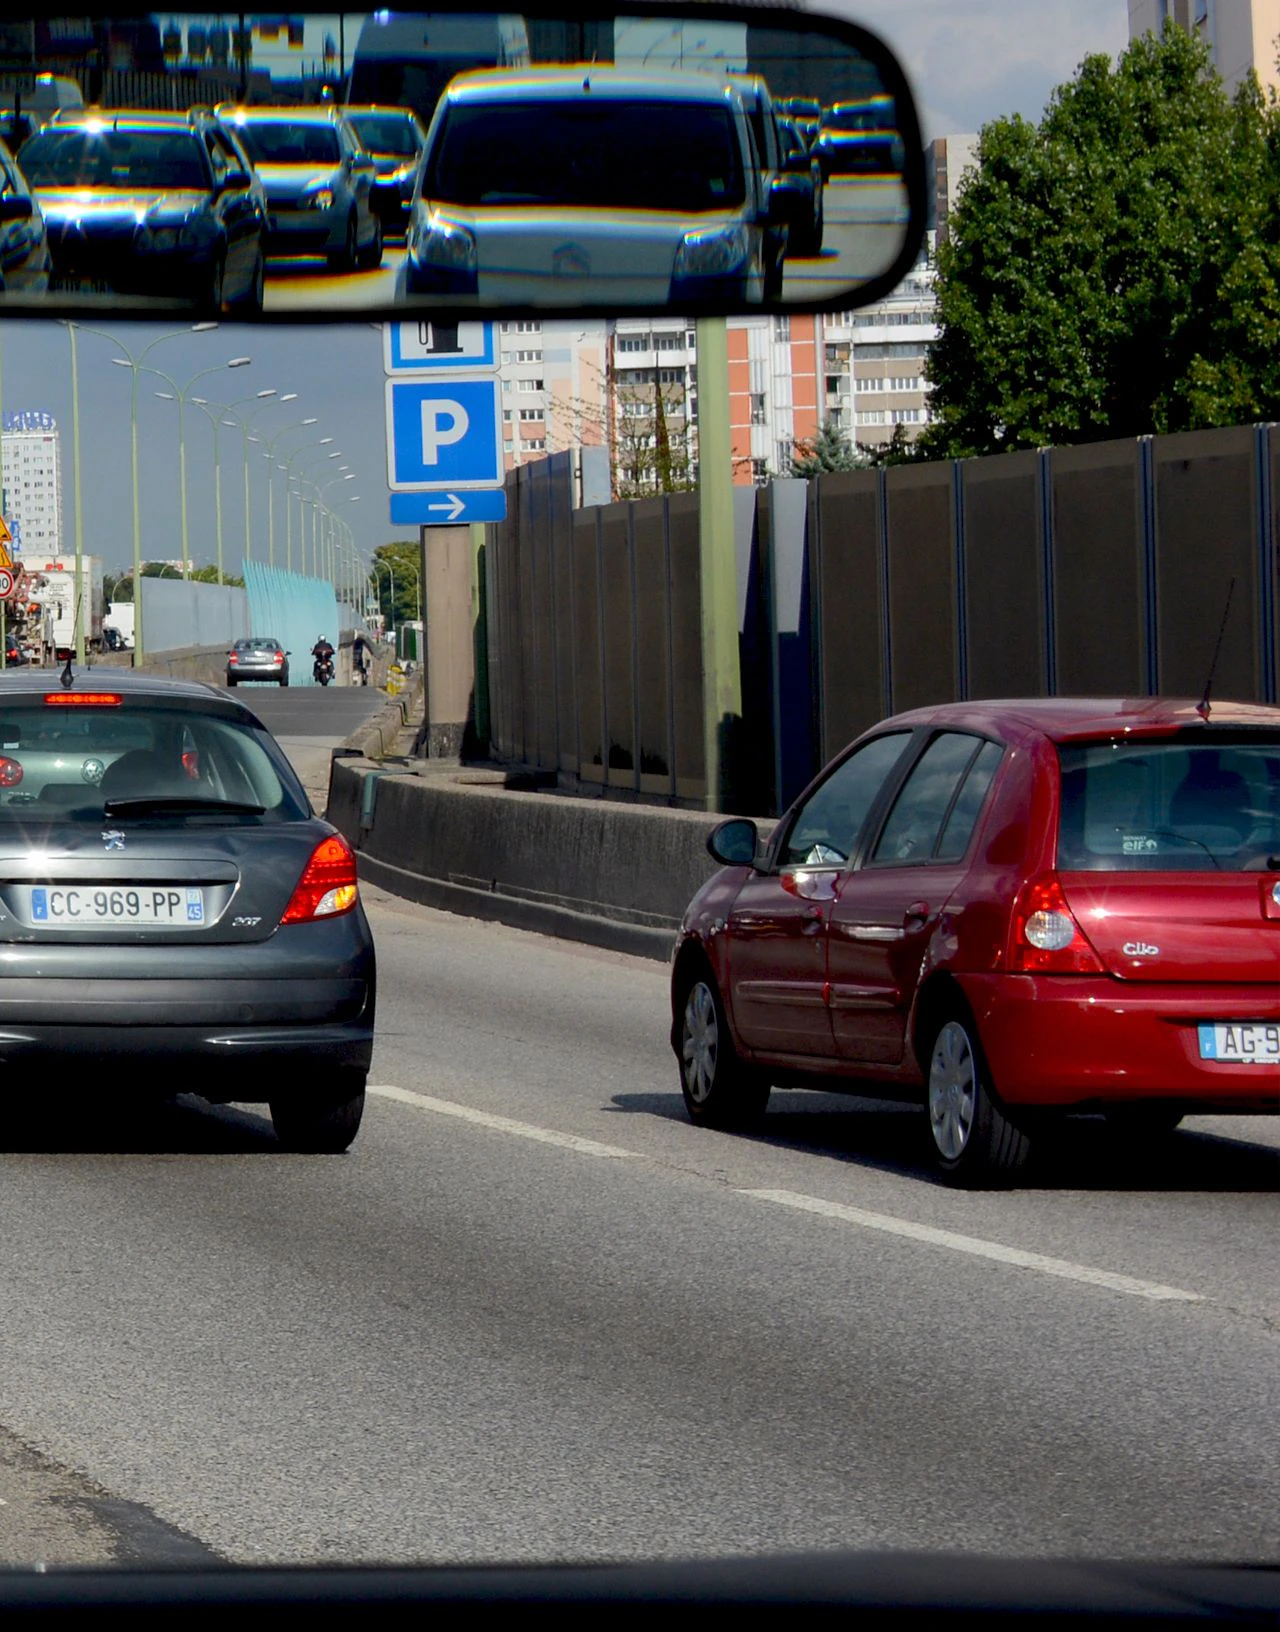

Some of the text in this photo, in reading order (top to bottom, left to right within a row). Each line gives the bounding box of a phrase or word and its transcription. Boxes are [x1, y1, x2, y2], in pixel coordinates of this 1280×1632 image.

[420, 399, 470, 465] P
[50, 891, 181, 917] CC-969-PP
[188, 906, 202, 920] 45
[1122, 942, 1159, 956] Clio
